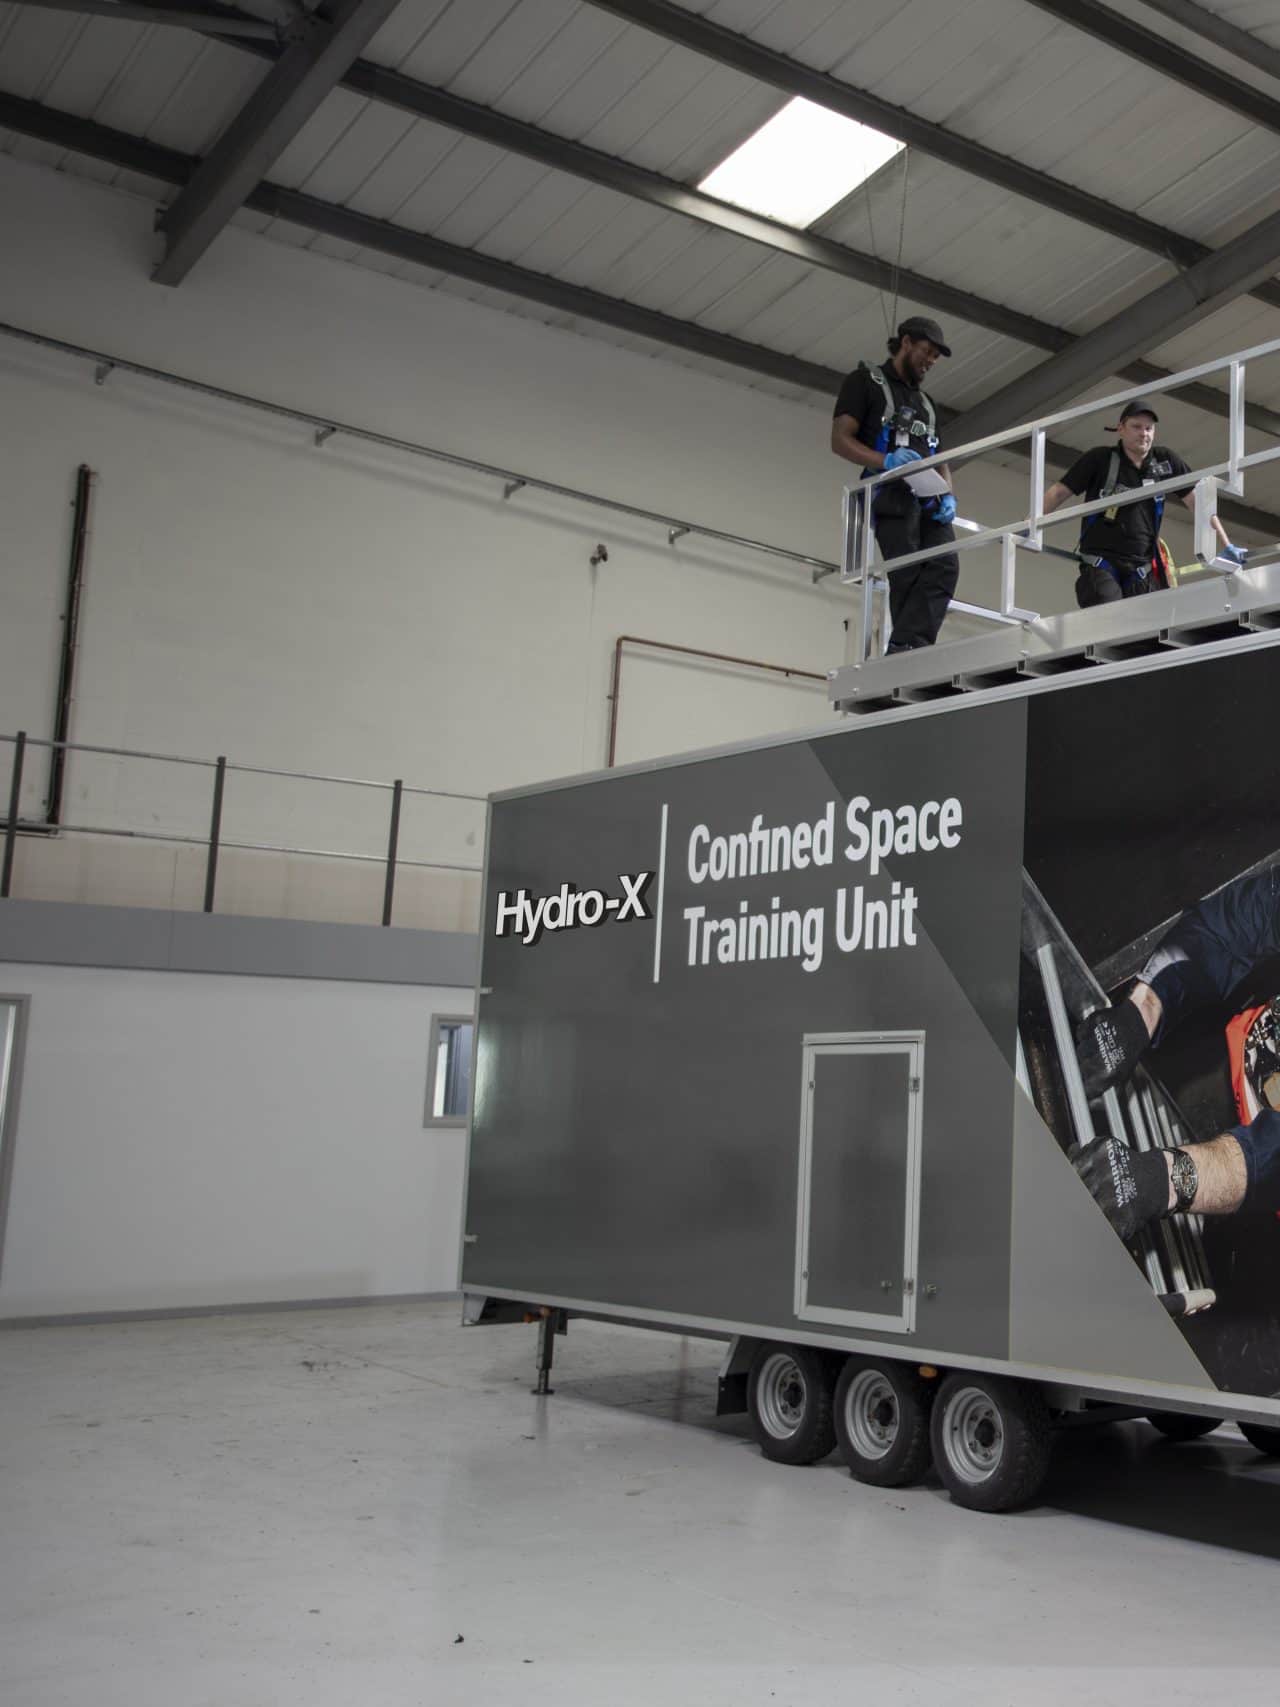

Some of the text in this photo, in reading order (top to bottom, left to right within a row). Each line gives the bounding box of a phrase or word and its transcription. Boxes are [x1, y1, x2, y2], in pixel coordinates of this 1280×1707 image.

[687, 796, 963, 884] Confined Space
[495, 871, 651, 945] Hydro-X
[683, 881, 919, 973] Training Unit
[1105, 1138, 1124, 1208] WARRIOR
